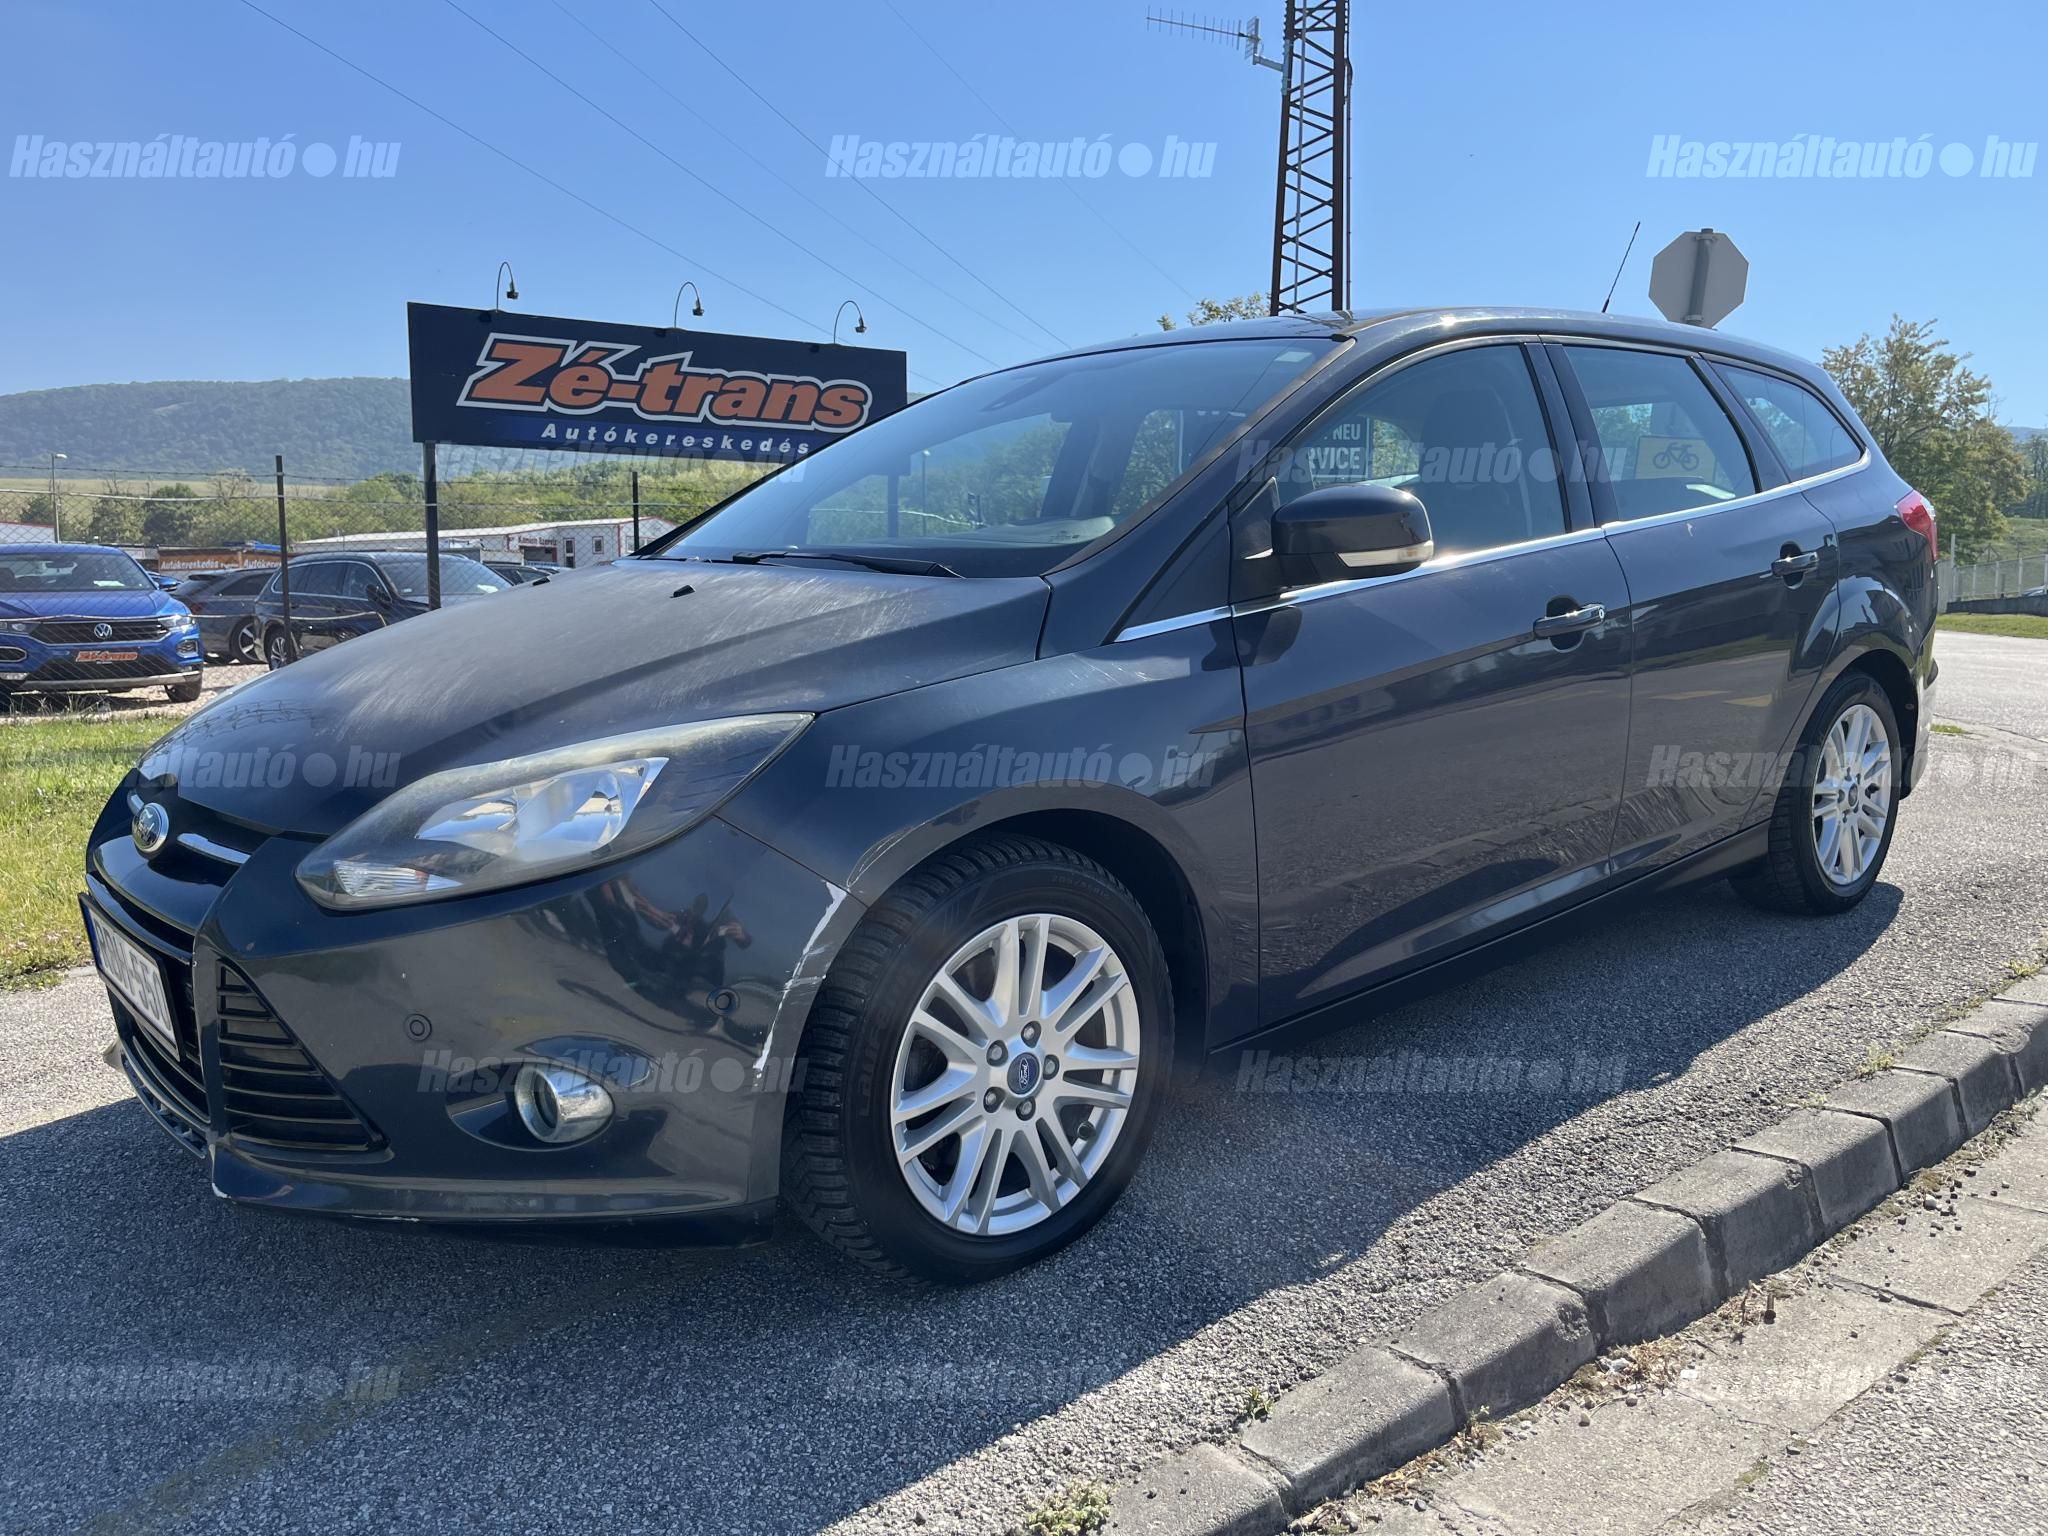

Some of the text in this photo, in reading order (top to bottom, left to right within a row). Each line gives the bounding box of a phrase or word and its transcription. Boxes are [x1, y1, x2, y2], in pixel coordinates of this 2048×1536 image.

[460, 335, 871, 431] Zé-trans
[541, 423, 809, 455] Autókereskedés
[1332, 423, 1361, 441] NEU
